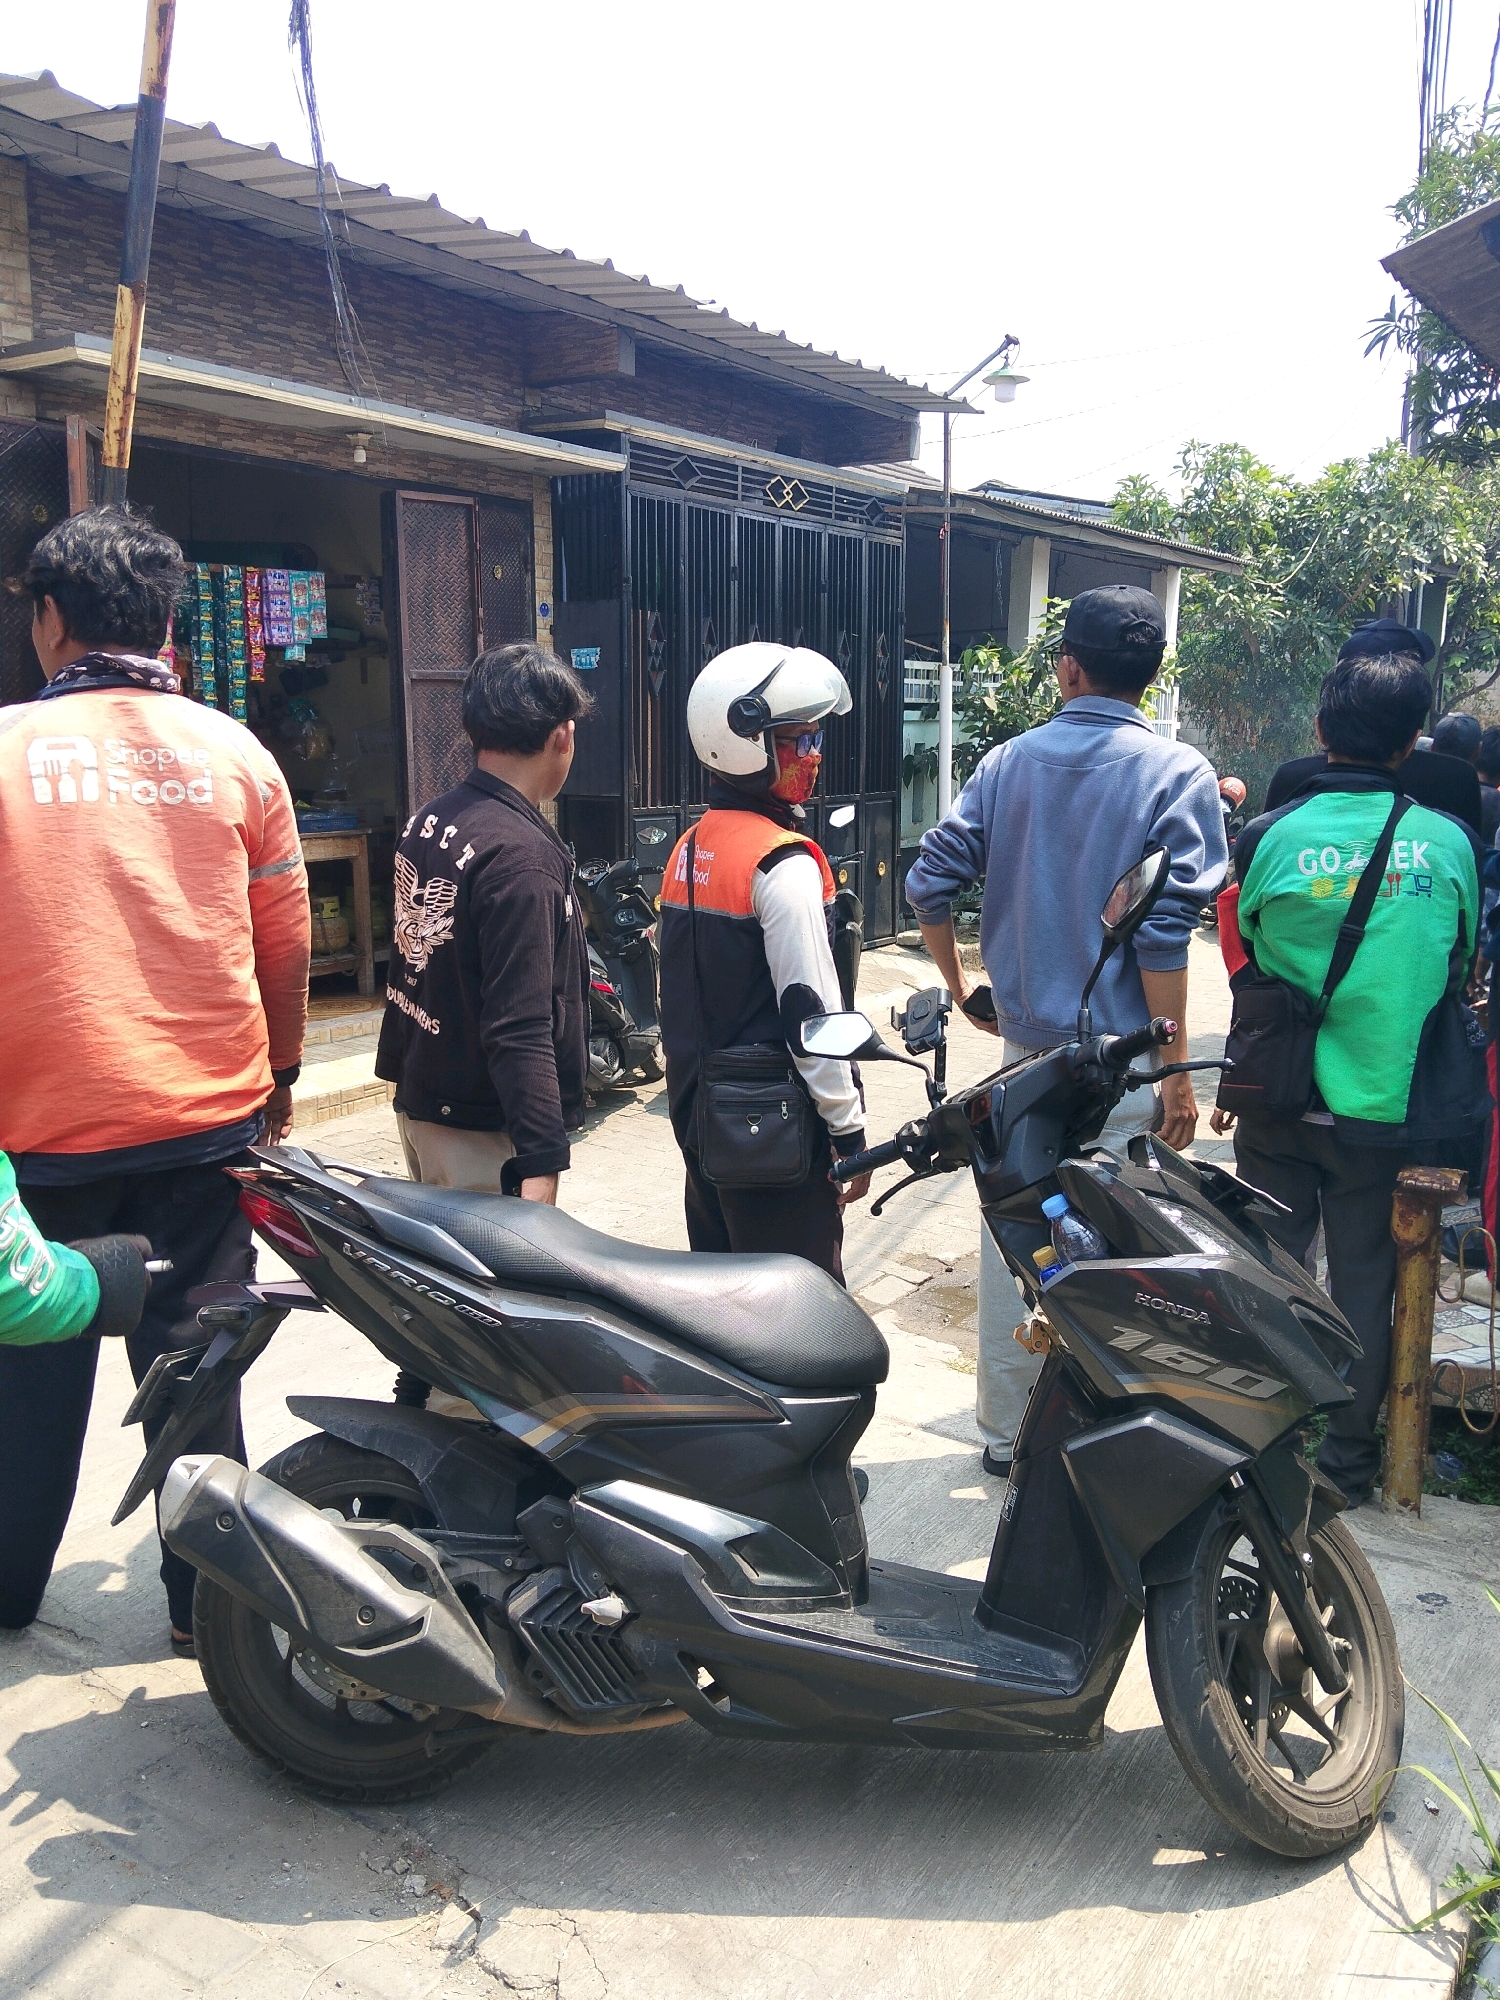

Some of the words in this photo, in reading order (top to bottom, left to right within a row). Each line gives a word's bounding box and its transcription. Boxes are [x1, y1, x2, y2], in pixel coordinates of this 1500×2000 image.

[104, 738, 210, 772] Shopee
[106, 767, 214, 806] Food
[1297, 845, 1341, 876] GO
[1134, 1292, 1212, 1325] HONDA
[1106, 1325, 1290, 1399] 160
